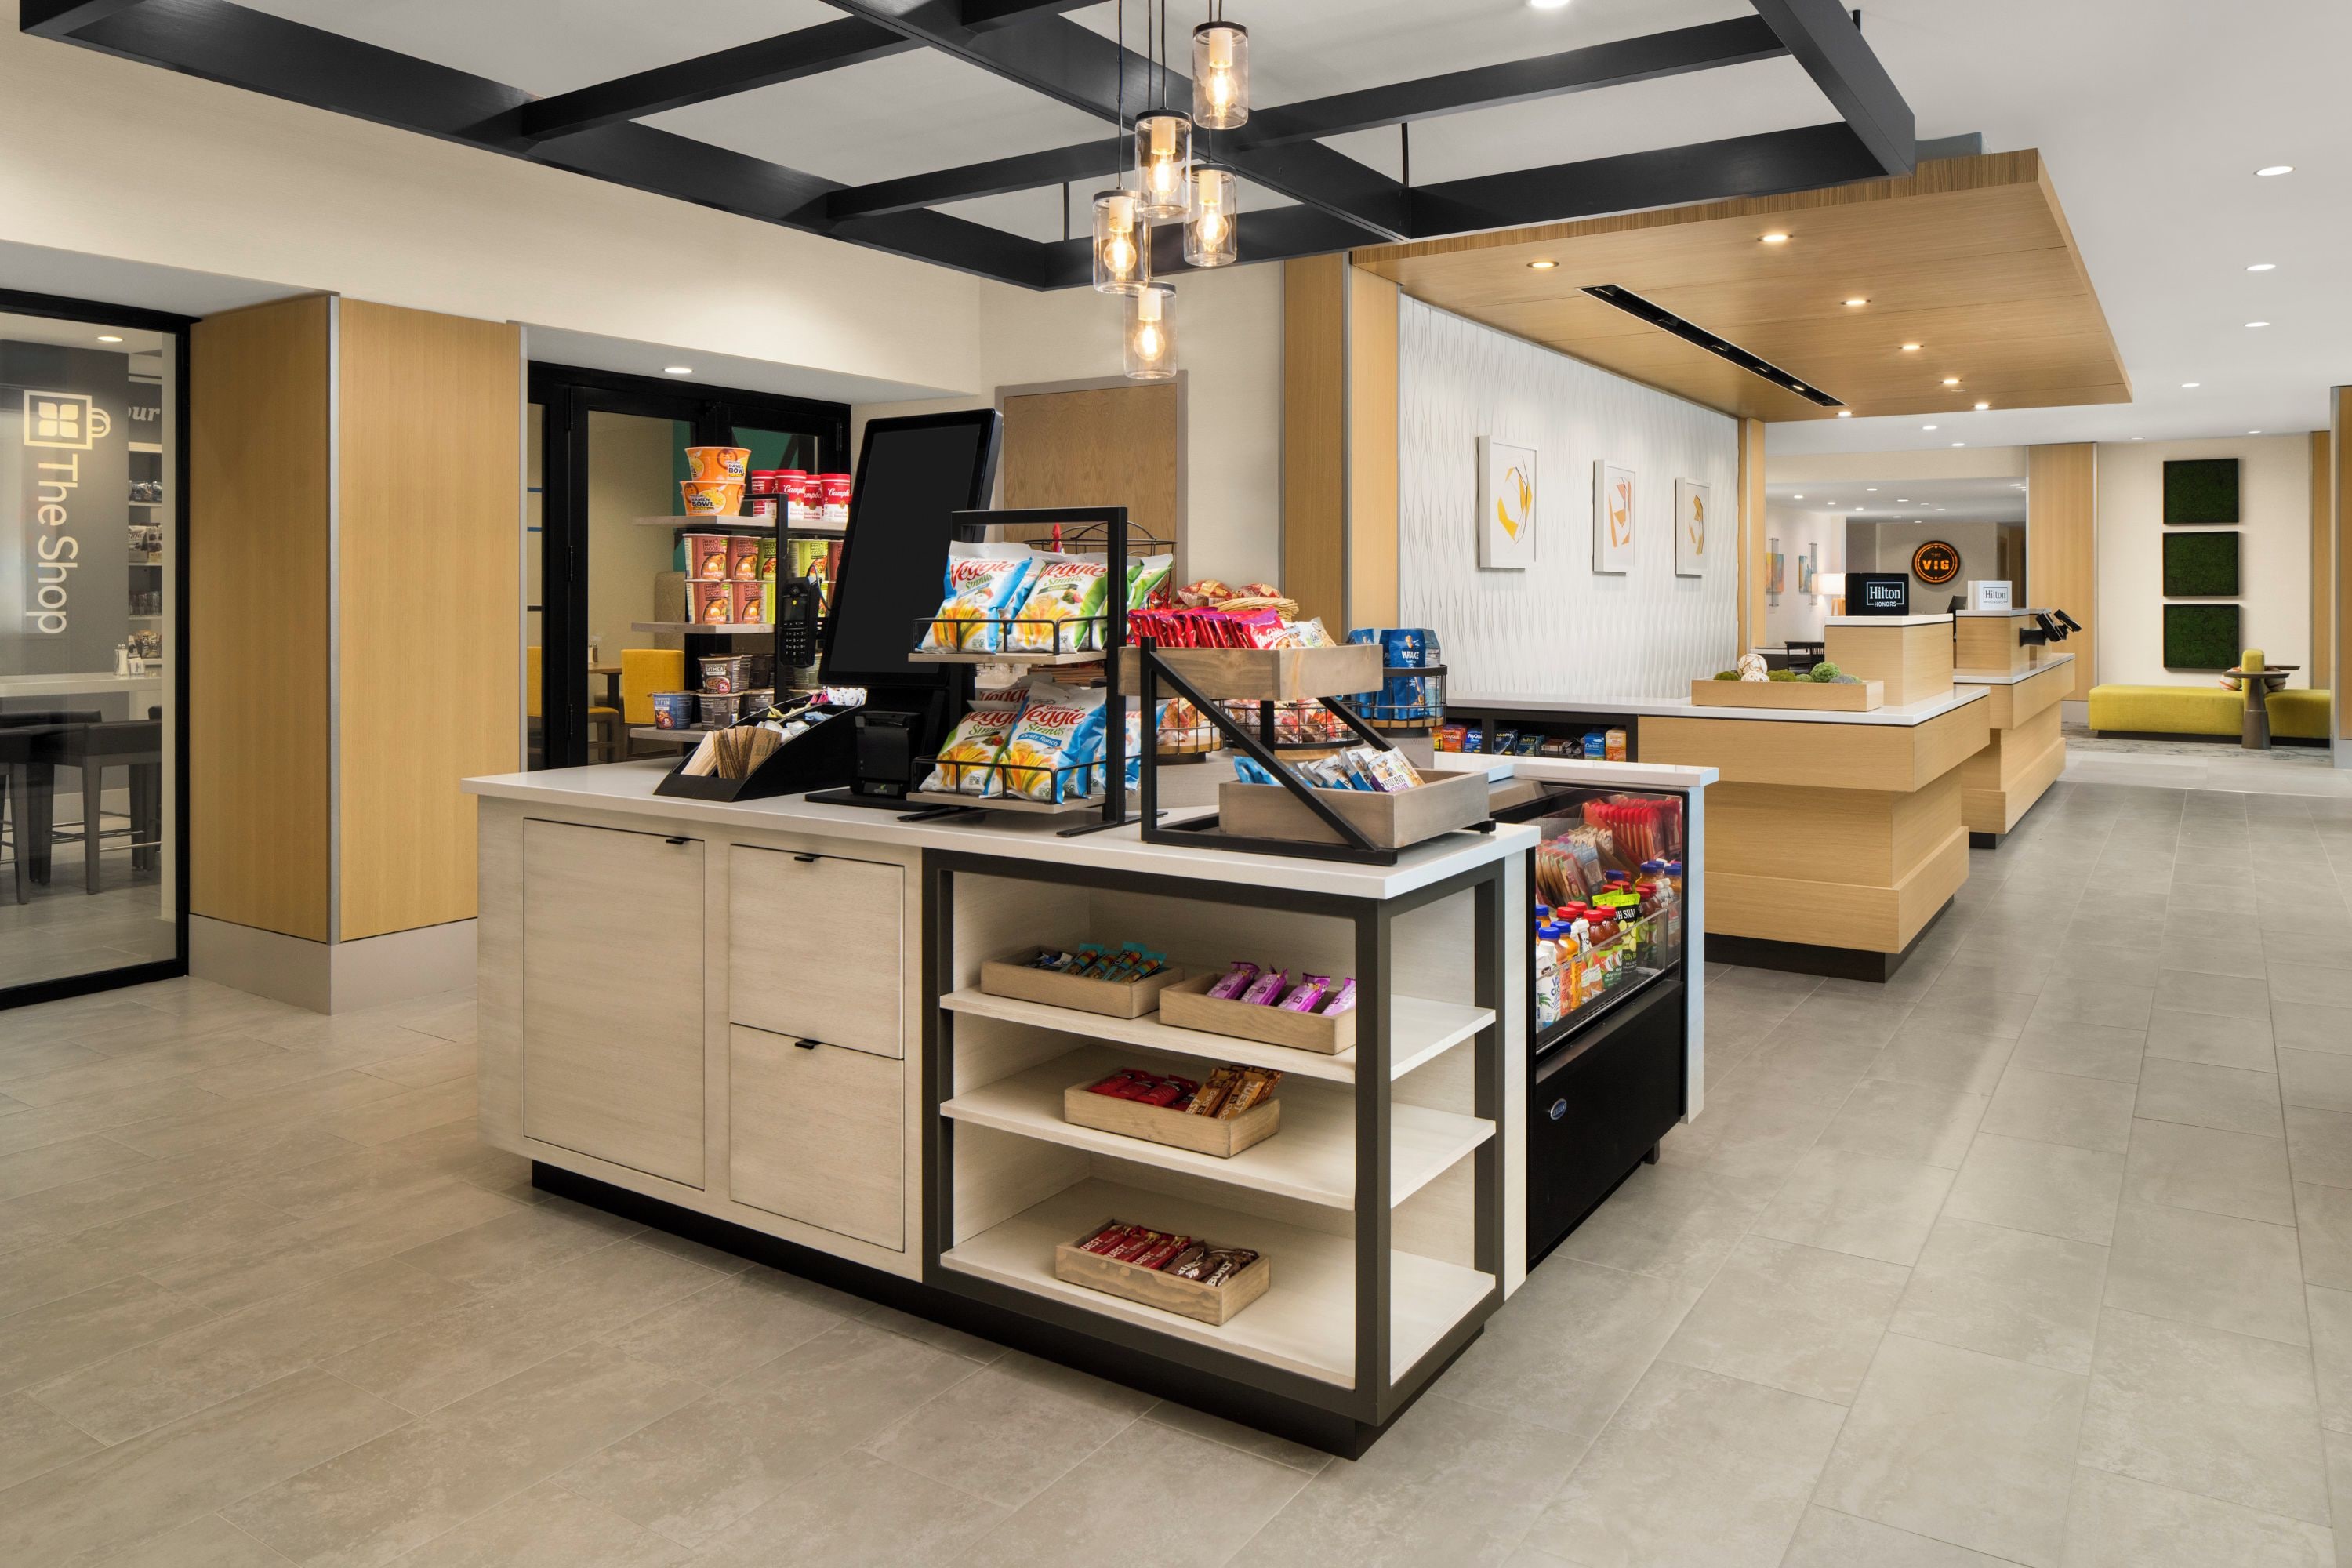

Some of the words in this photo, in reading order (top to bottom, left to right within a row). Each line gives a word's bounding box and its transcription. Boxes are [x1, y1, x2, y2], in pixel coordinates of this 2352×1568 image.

[38, 453, 78, 527] The
[1039, 561, 1107, 579] Veggie
[1922, 559, 1950, 571] VIG
[950, 560, 1015, 589] Veggie
[25, 535, 78, 635] Shop
[1870, 586, 1901, 600] Hilton
[1985, 590, 2006, 599] Hilton
[1018, 704, 1086, 728] Veggie
[1024, 723, 1065, 736] Straws
[1039, 735, 1058, 746] Ranch
[1234, 1081, 1259, 1113] QUEST
